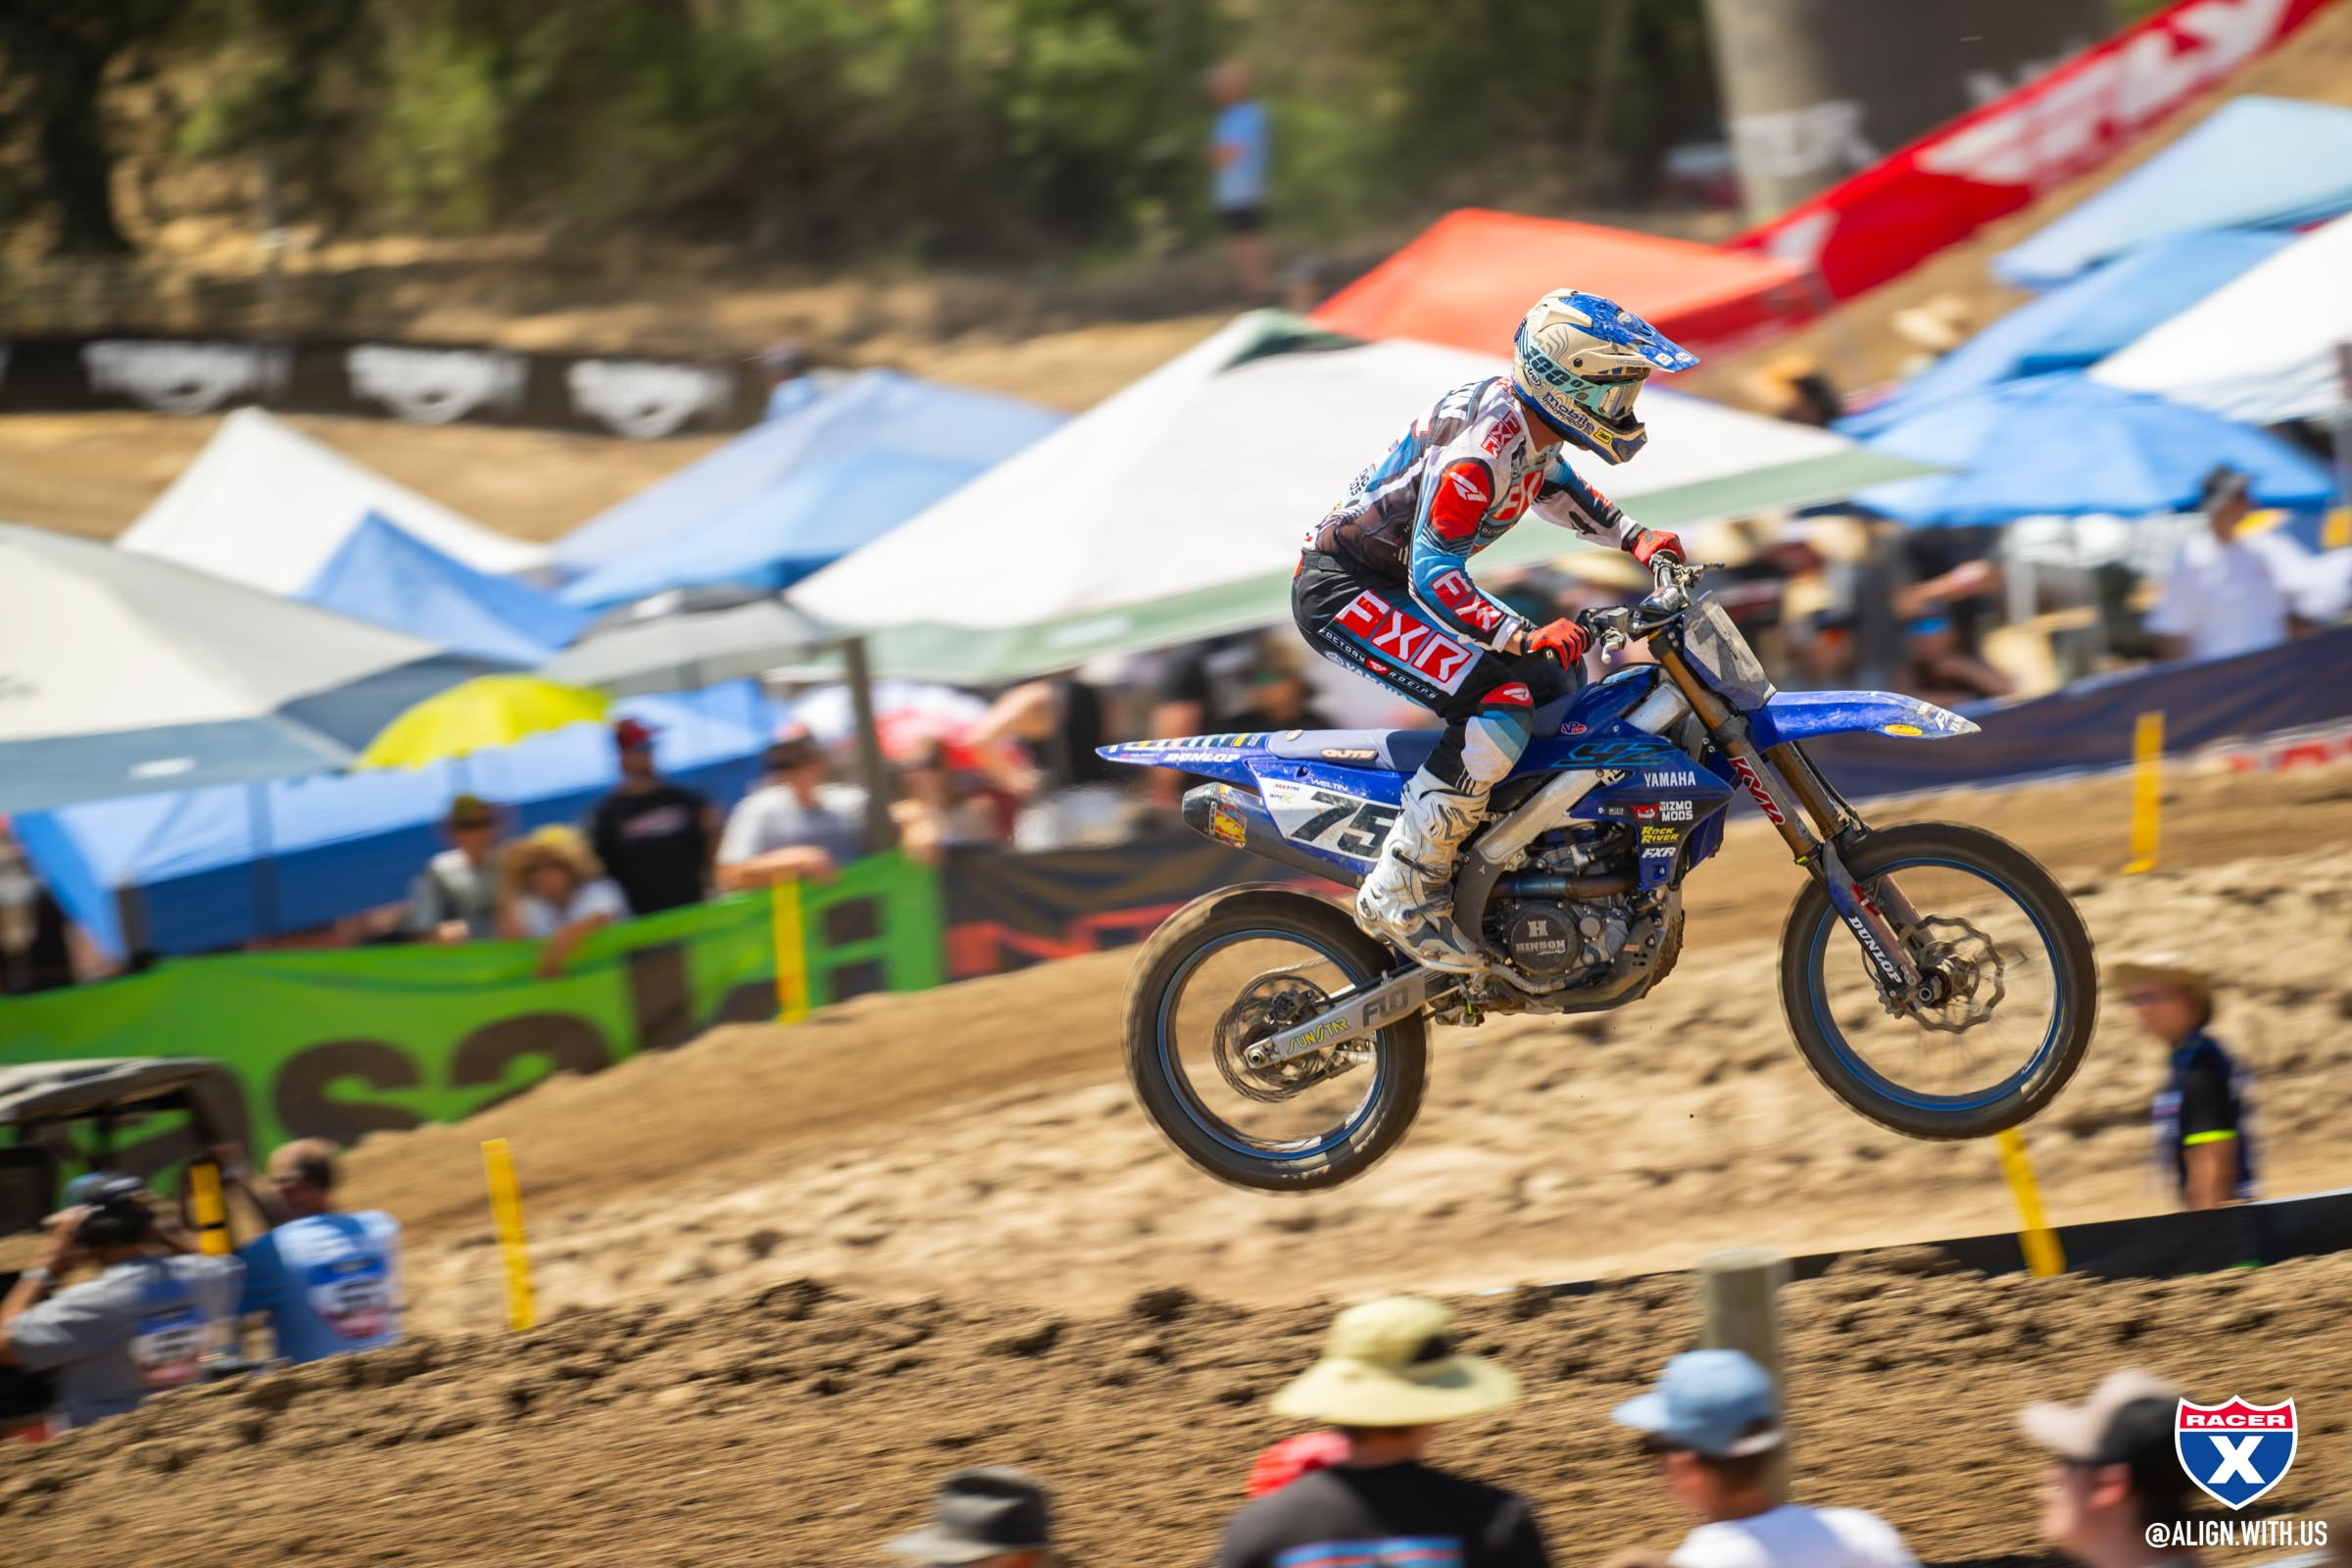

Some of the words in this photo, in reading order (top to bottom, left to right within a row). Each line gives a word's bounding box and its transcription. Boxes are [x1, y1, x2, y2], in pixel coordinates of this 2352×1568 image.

[1525, 345, 1595, 401] 100%
[1544, 391, 1595, 432] mobile
[1481, 410, 1522, 459] FXR
[1431, 568, 1503, 632] FXR
[1334, 588, 1473, 683] FXR
[1163, 753, 1242, 763] DUNLOP
[1321, 749, 1377, 760] GUTS
[1310, 777, 1349, 792] WELTIN
[1643, 770, 1696, 788] YAMAHA
[1659, 800, 1692, 812] GIZMO
[1291, 791, 1405, 858] 75
[1661, 810, 1693, 821] MODS
[1641, 834, 1679, 845] RIVER
[1642, 825, 1675, 836] ROCK
[1642, 847, 1677, 858] FXR
[1515, 940, 1565, 954] HINSON
[1848, 916, 1903, 984] DUNLOP
[1362, 986, 1409, 1027] FLO
[1287, 1017, 1350, 1054] SUNSTAR
